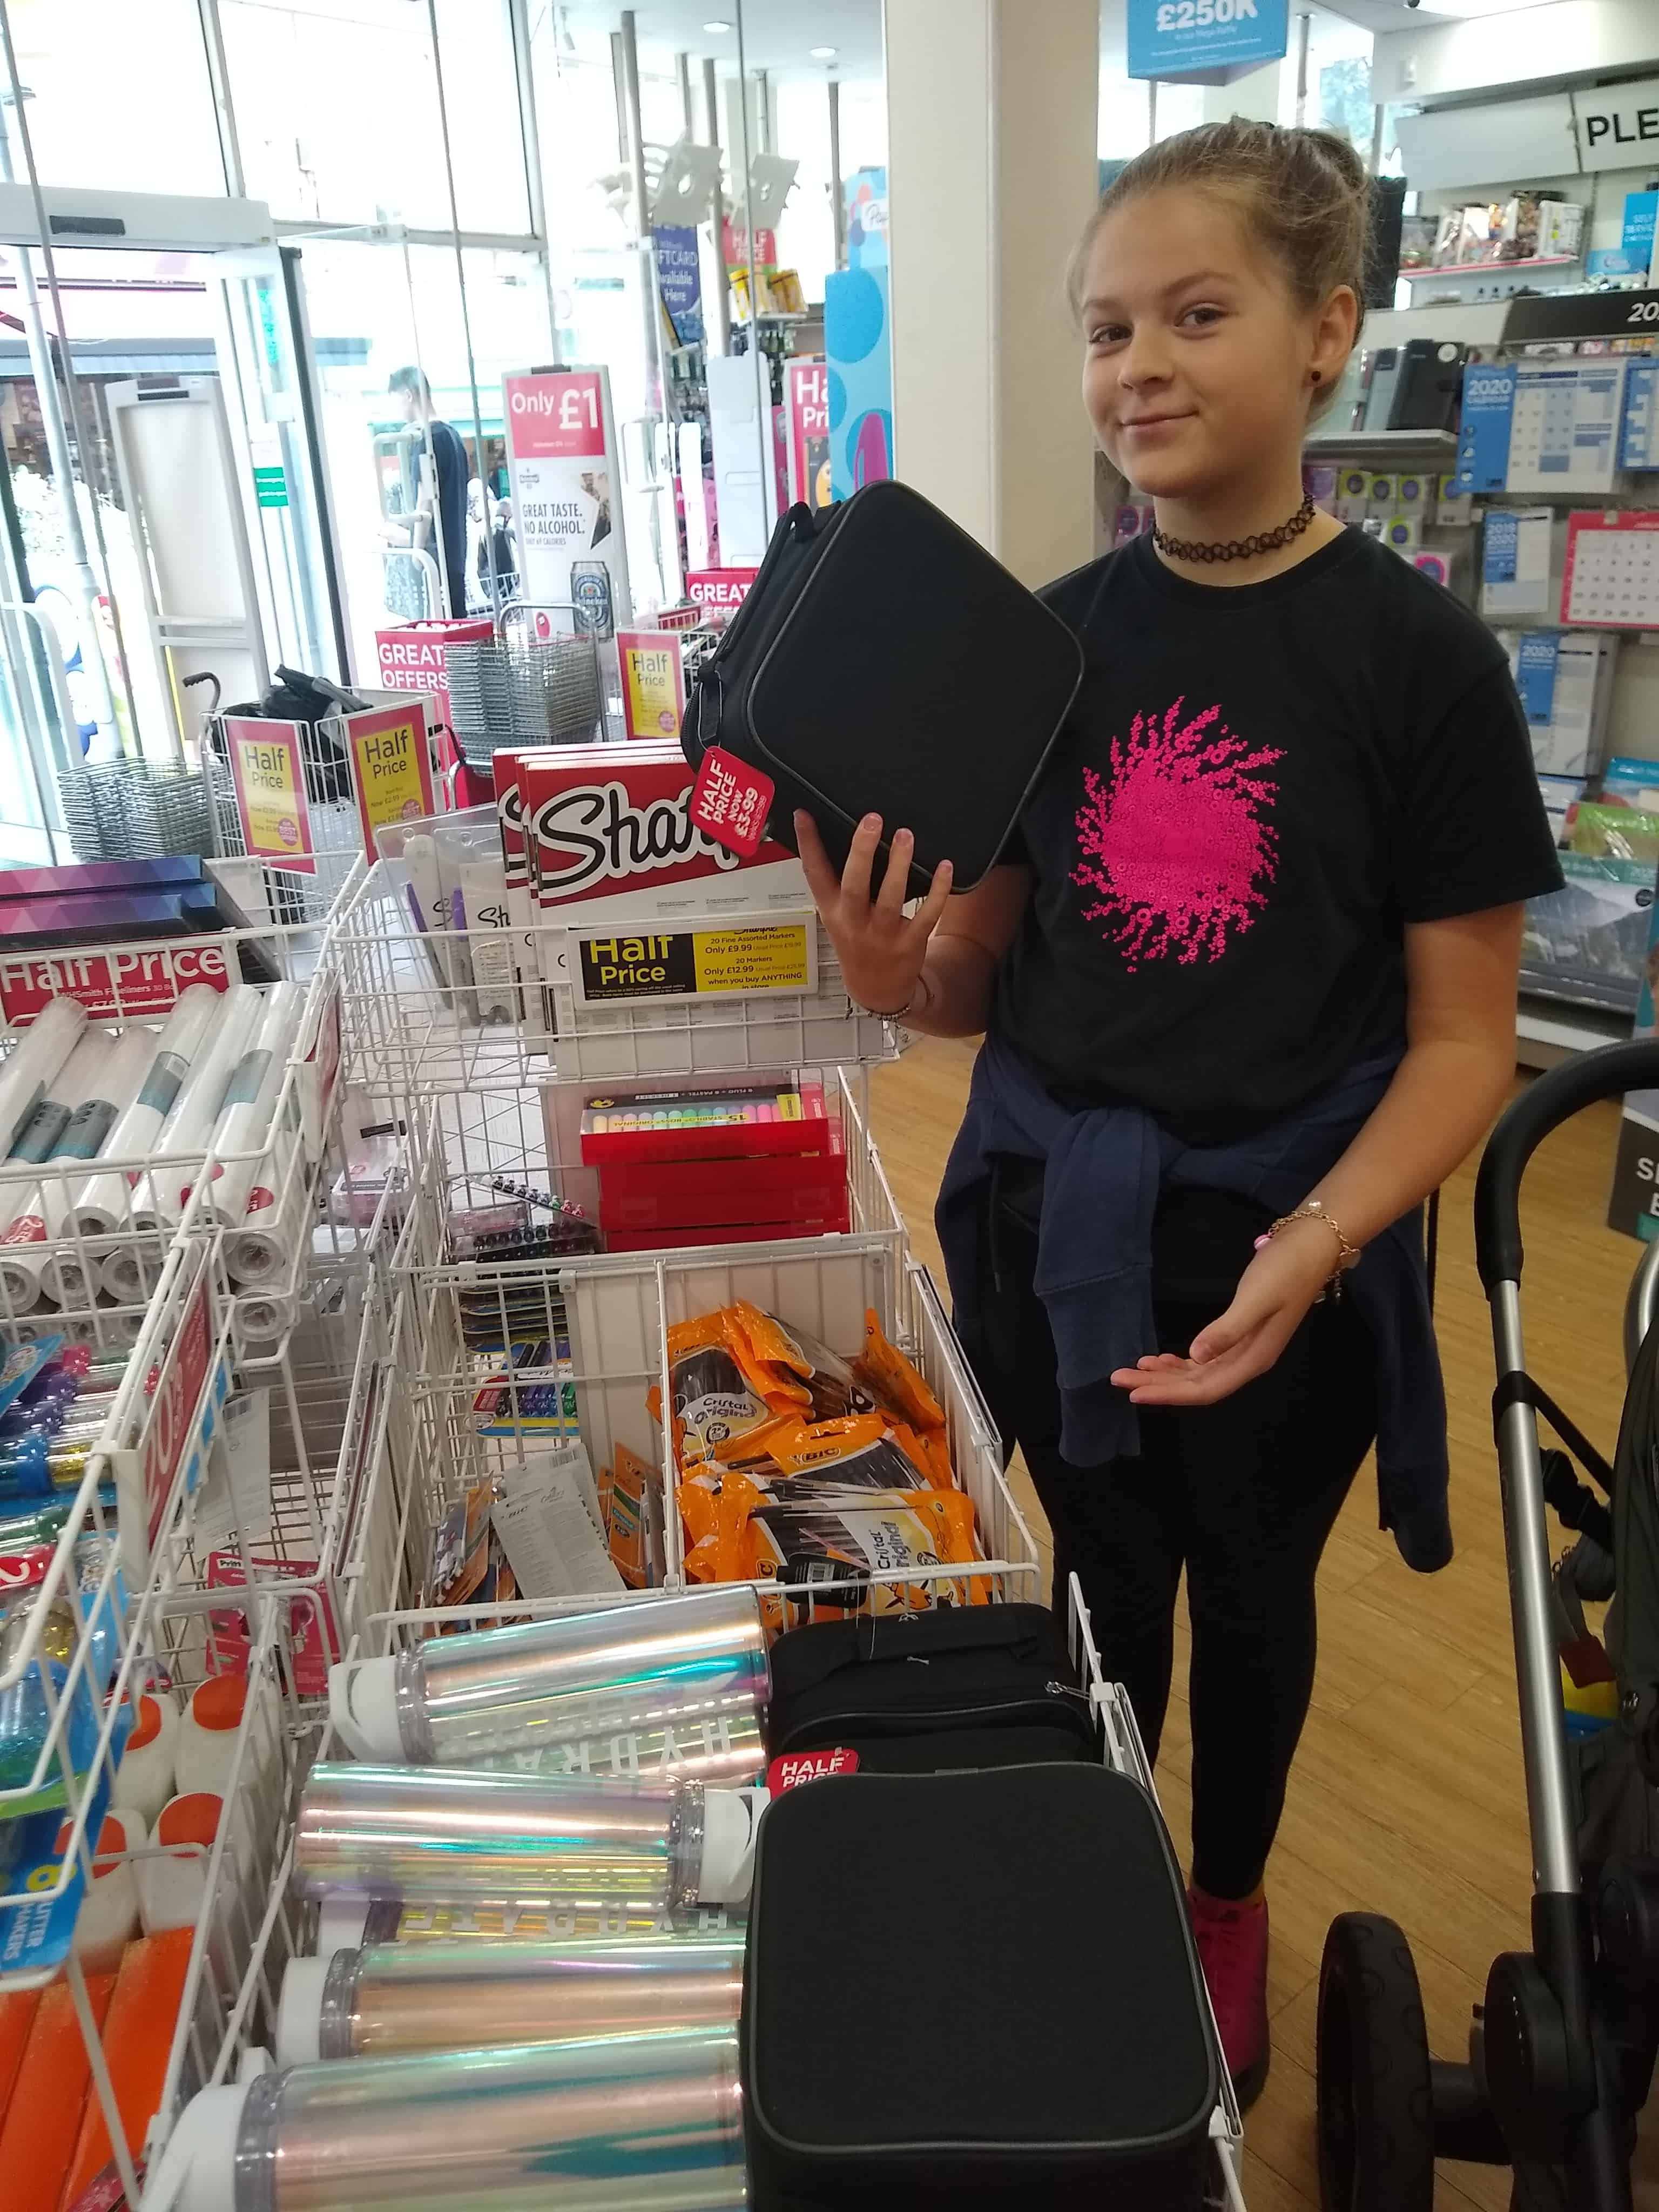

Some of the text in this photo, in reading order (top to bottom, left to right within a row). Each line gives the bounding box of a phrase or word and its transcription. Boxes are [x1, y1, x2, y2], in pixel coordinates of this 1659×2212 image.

[1587, 108, 1659, 146] PLE
[659, 250, 698, 266] FTCARD
[1627, 301, 1659, 323] 20
[1467, 379, 1513, 395] 2020
[511, 387, 598, 430] Only £1
[522, 503, 583, 518] GREAT TASTE.
[524, 521, 536, 535] NO
[690, 583, 752, 603] GREAT
[379, 643, 444, 666] GREAT
[632, 653, 667, 672] Half
[382, 669, 449, 690] OFFERS
[637, 673, 665, 686] Price
[365, 729, 408, 763] Half
[244, 745, 285, 772] Half
[373, 759, 407, 779] Price
[251, 771, 284, 788] Price
[697, 759, 724, 821] HALF
[712, 771, 737, 824] PRICE
[727, 788, 744, 821] NOW
[734, 786, 758, 838] £3.99
[738, 933, 768, 942] Assorted
[590, 935, 674, 964] Half
[705, 946, 725, 955] Only
[1, 957, 93, 993] Half
[600, 963, 666, 986] Price
[704, 967, 725, 976] Only
[708, 972, 802, 985] when you buy ANYTHING
[105, 985, 151, 996] Feliners
[703, 1397, 749, 1411] Cristal
[805, 1448, 837, 1461] BIC
[869, 1529, 891, 1570] Cristal
[781, 1756, 845, 1777] HALF
